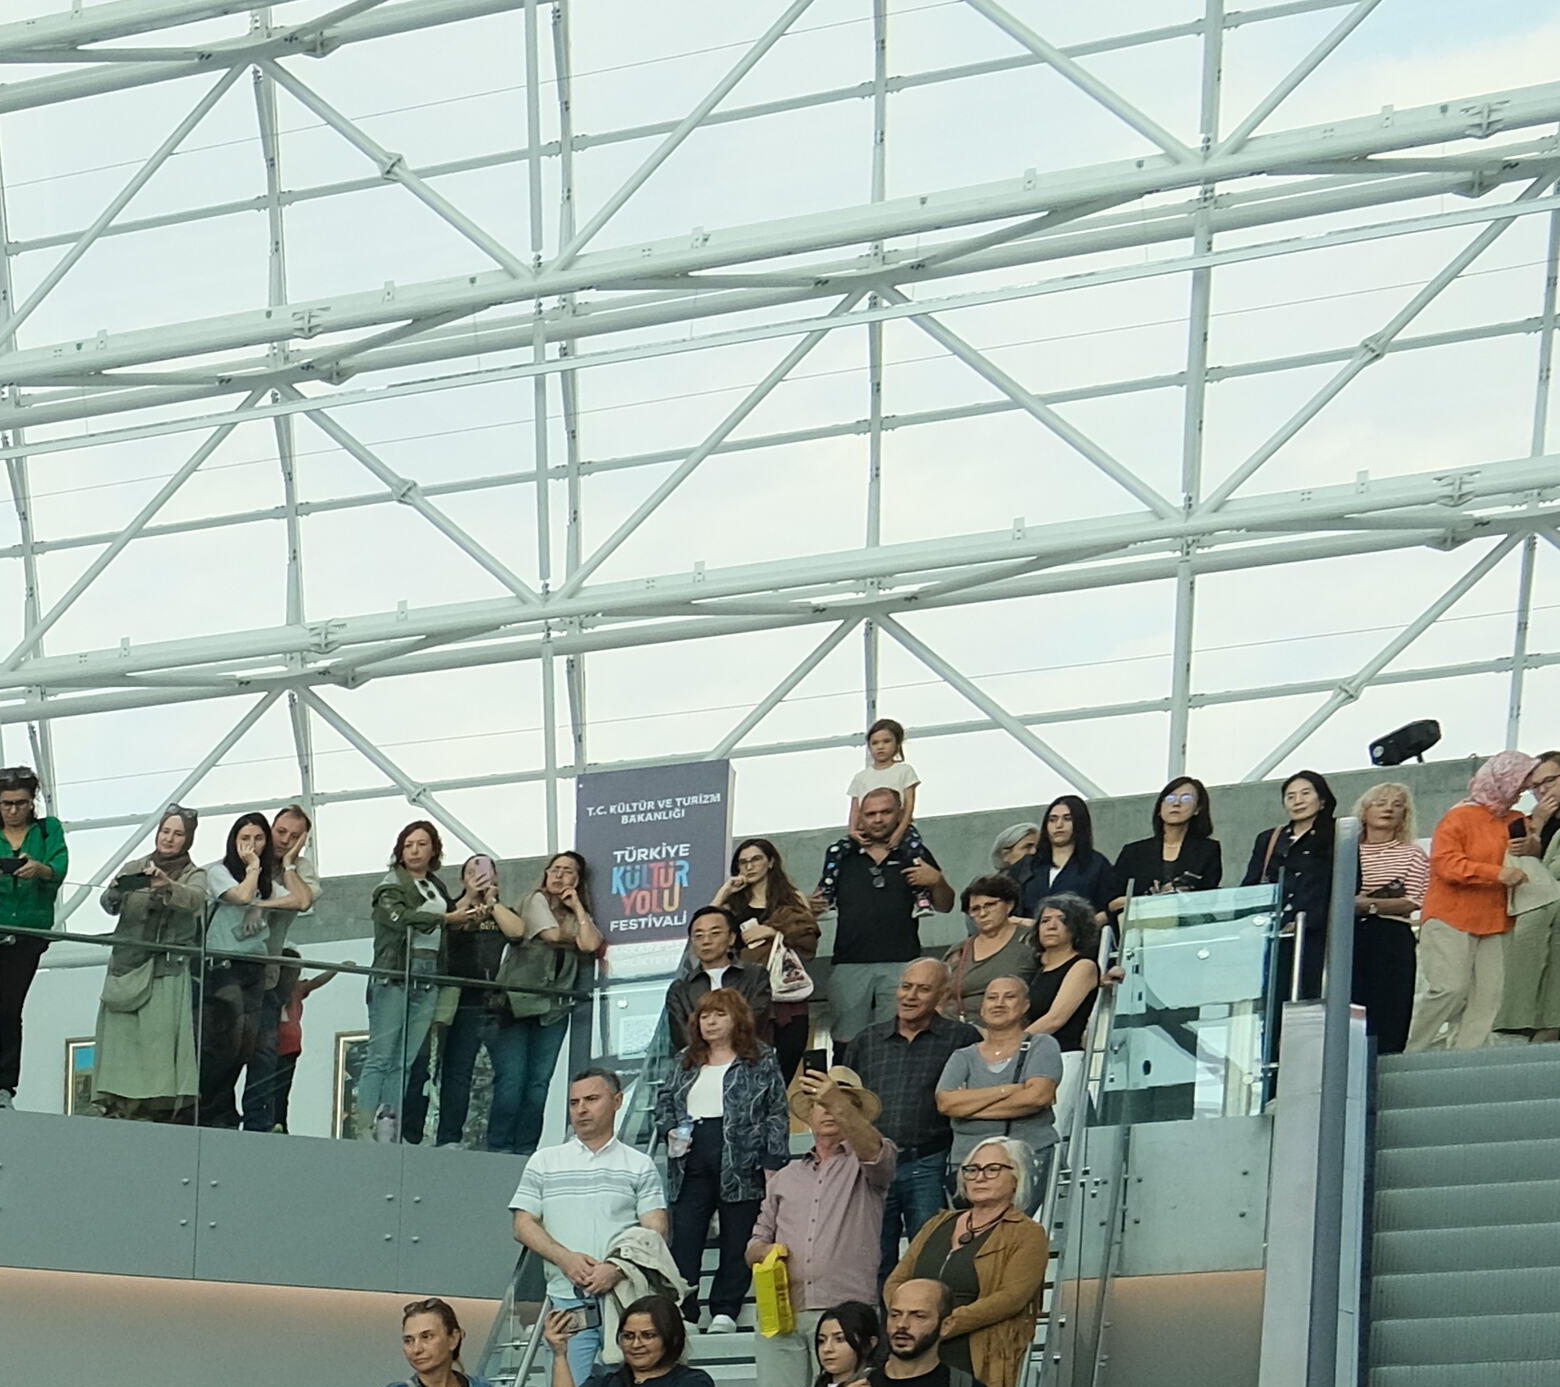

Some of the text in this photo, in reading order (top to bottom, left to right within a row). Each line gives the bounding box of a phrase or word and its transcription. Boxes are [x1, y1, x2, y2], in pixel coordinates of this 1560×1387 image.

[587, 793, 721, 816] T.C. KÜLTÜR VE TURİZM
[621, 808, 685, 825] BAKANLIĞI
[613, 842, 690, 863] TÜRKİYE
[611, 860, 689, 896] KÜLTÜR
[621, 883, 681, 916] YOLU
[610, 911, 687, 932] FESTİVALİ
